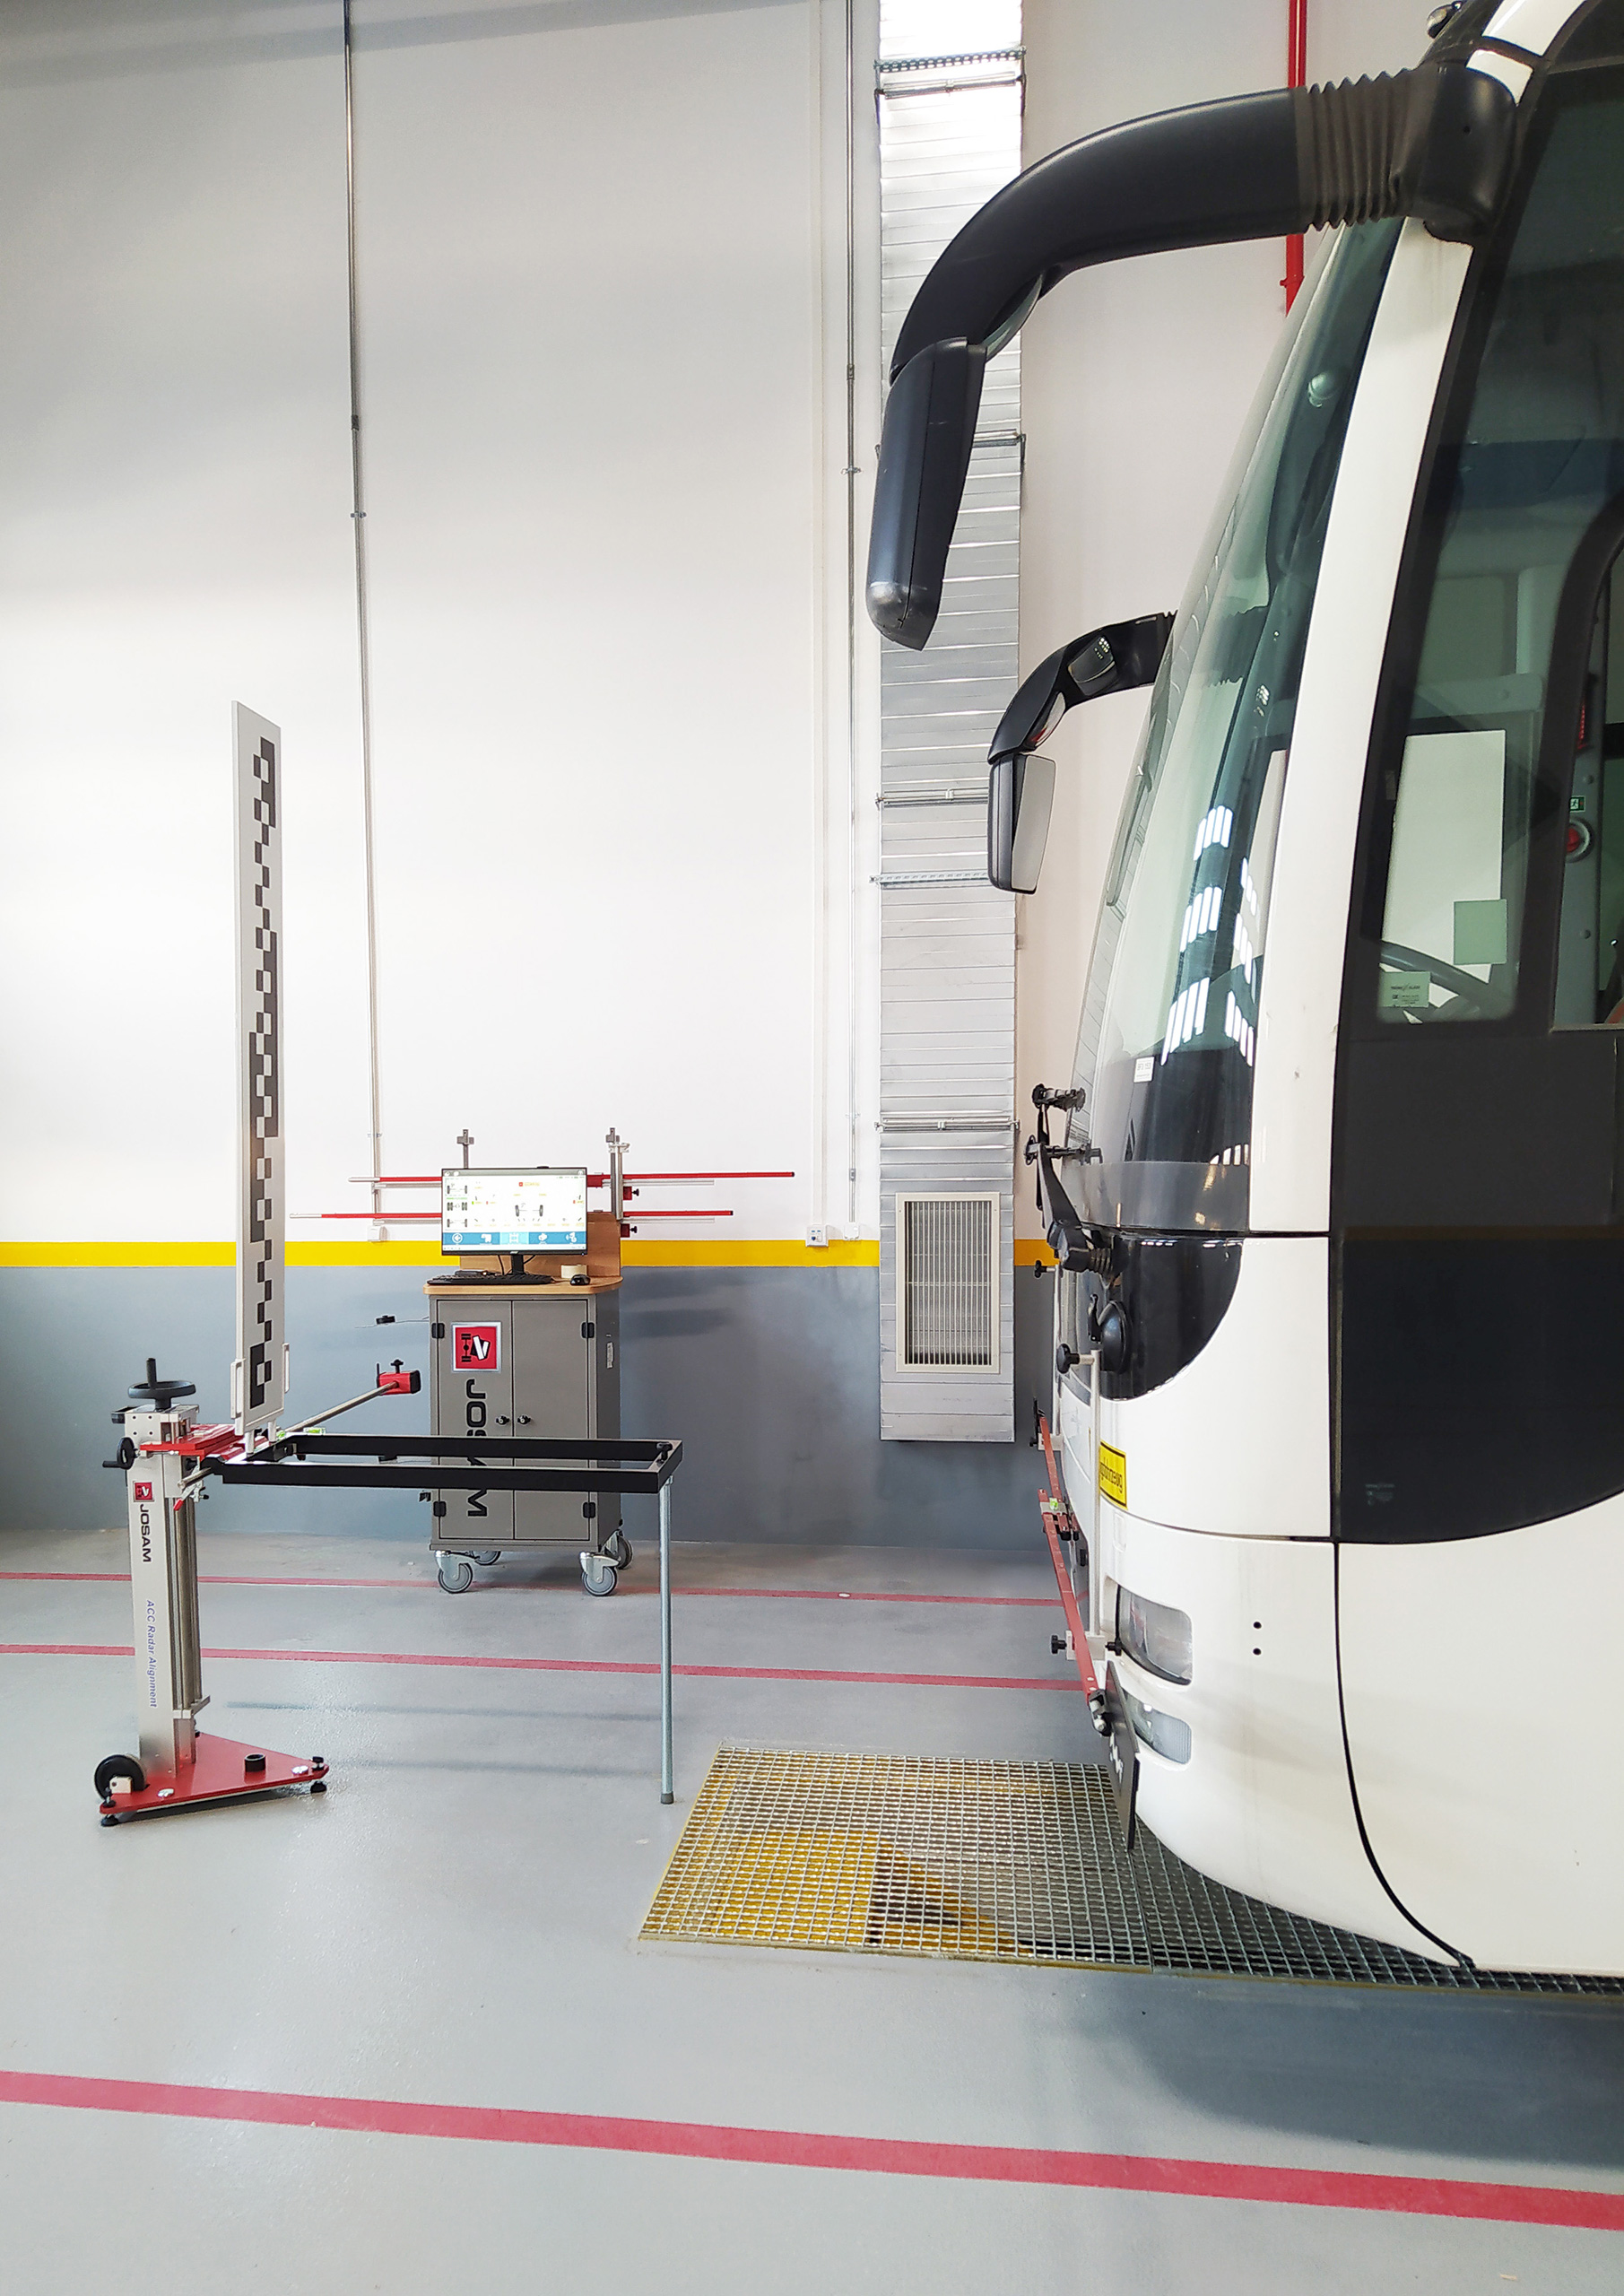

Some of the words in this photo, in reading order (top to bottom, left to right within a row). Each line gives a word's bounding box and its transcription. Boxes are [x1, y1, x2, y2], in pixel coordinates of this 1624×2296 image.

[466, 1378, 487, 1518] JOM
[140, 1503, 152, 1562] JOSAM
[147, 1600, 156, 1623] ACC
[147, 1625, 157, 1655] Radar
[147, 1657, 158, 1708] Alignment
